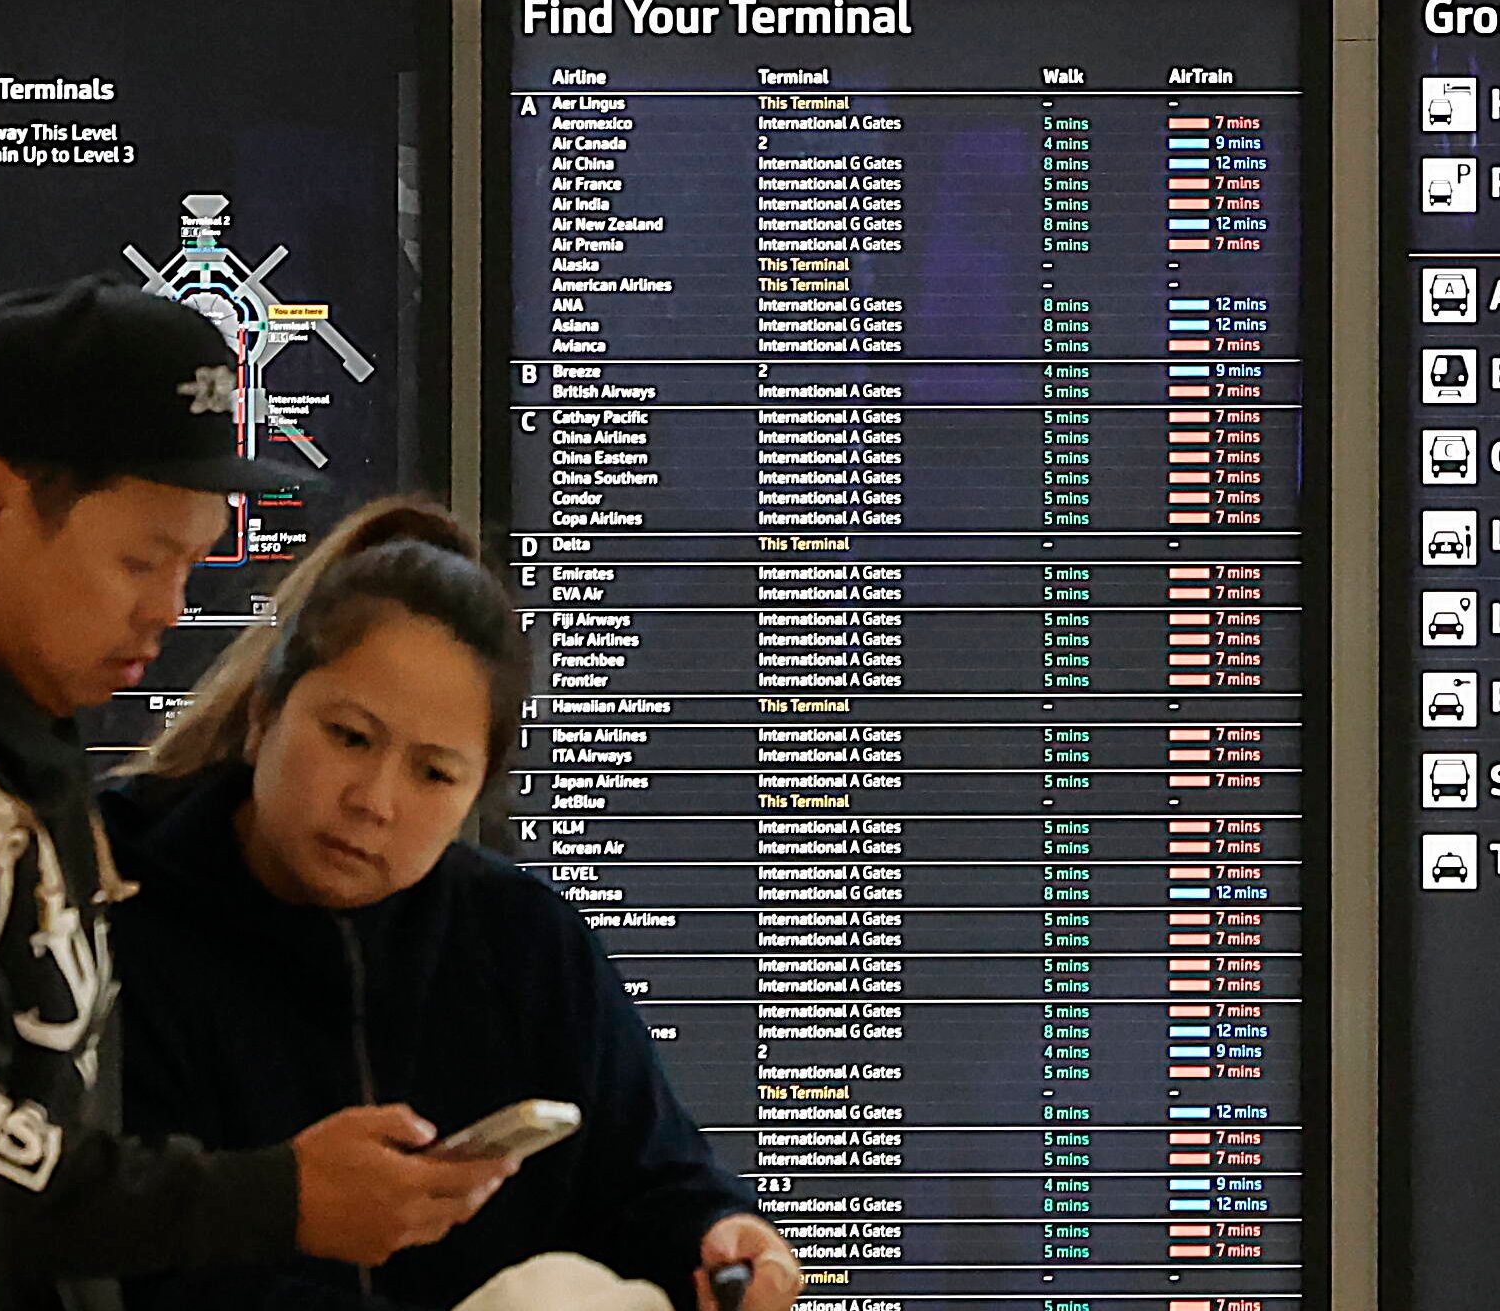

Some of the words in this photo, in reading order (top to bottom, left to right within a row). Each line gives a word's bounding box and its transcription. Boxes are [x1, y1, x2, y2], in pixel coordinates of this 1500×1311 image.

[551, 68, 607, 85] Airline
[757, 68, 830, 85] Terminal
[1042, 68, 1084, 84] Walk
[1168, 67, 1233, 84] AirTrain
[30, 123, 68, 141] This
[71, 123, 118, 142] Level
[22, 145, 48, 167] Up
[50, 147, 70, 163] to
[73, 145, 120, 164] Level
[122, 145, 135, 164] 3
[551, 277, 618, 292] American
[619, 277, 673, 292] Airlines
[757, 277, 788, 292] This
[789, 277, 850, 292] Terminal
[552, 470, 592, 486] China
[593, 470, 658, 485] Southern
